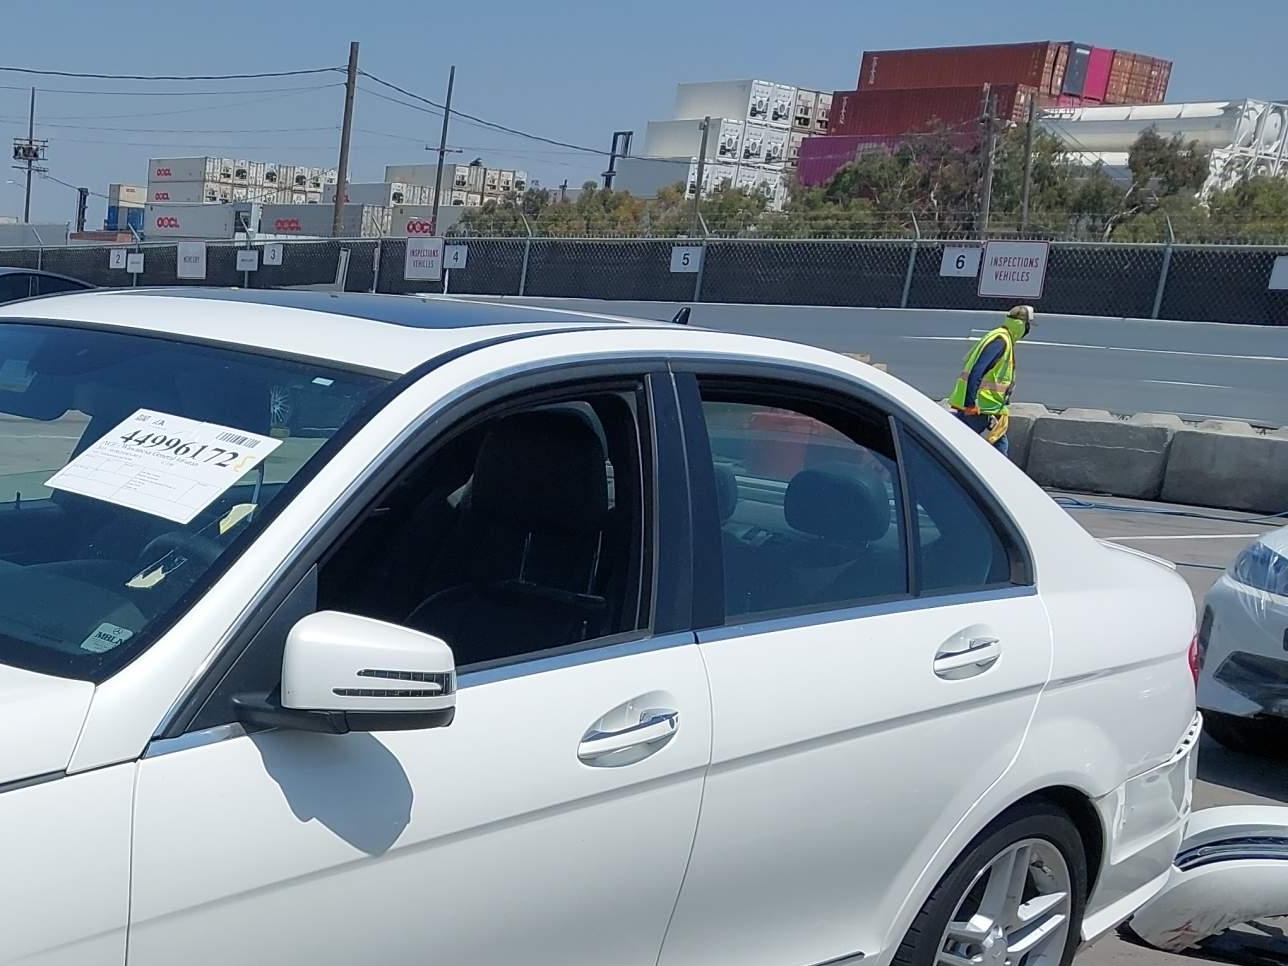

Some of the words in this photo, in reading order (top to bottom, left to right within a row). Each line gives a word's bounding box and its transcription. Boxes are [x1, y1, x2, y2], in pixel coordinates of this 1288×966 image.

[156, 217, 179, 228] OOCL
[275, 219, 301, 231] OOCL
[115, 254, 120, 264] 2
[270, 249, 276, 260] 3
[452, 252, 458, 262] 4
[682, 252, 690, 266] 5
[956, 254, 966, 270] 6
[990, 256, 1039, 268] INSPECTIONS
[994, 270, 1030, 282] VEHICLES
[120, 430, 239, 468] 44996172
